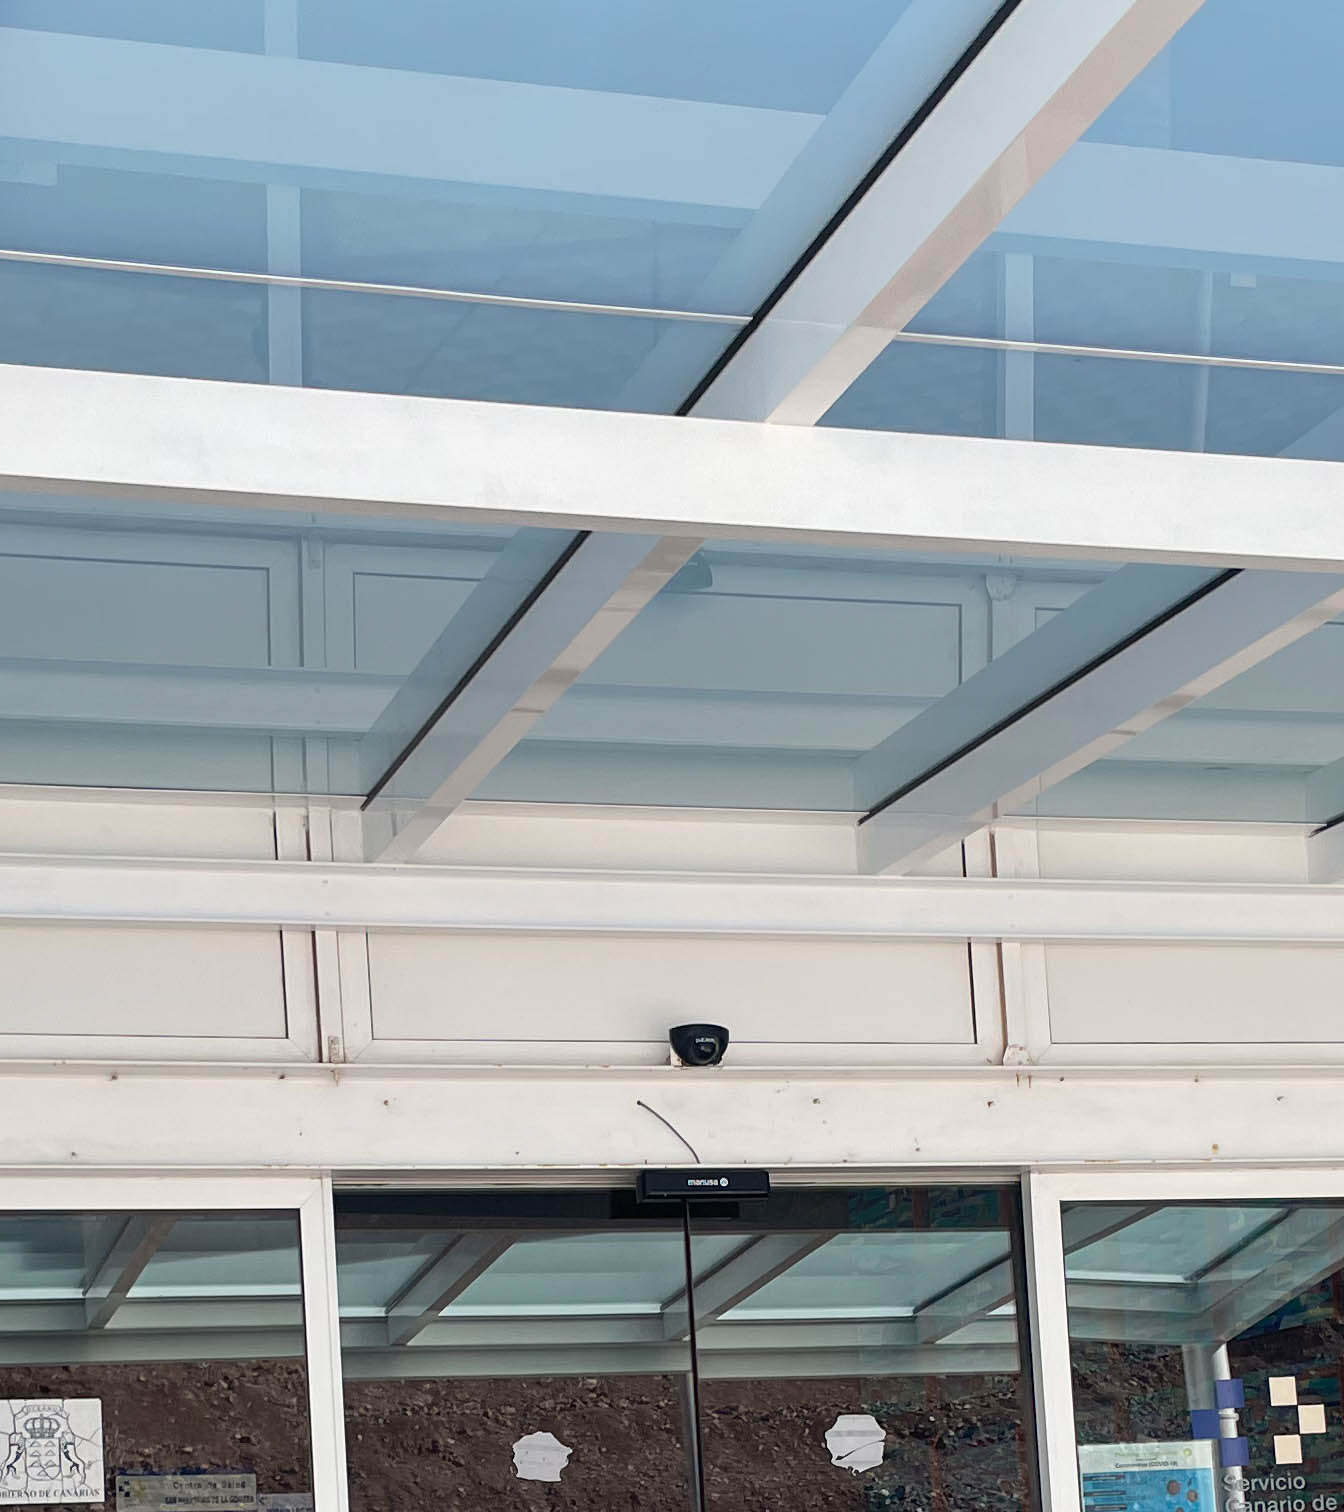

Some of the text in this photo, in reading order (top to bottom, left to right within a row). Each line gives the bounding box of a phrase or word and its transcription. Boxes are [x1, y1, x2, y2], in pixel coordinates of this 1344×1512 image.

[1224, 1472, 1306, 1492] Servicio
[39, 1489, 51, 1498] DE
[54, 1488, 100, 1498] CANARIAS
[1312, 1494, 1338, 1512] de
